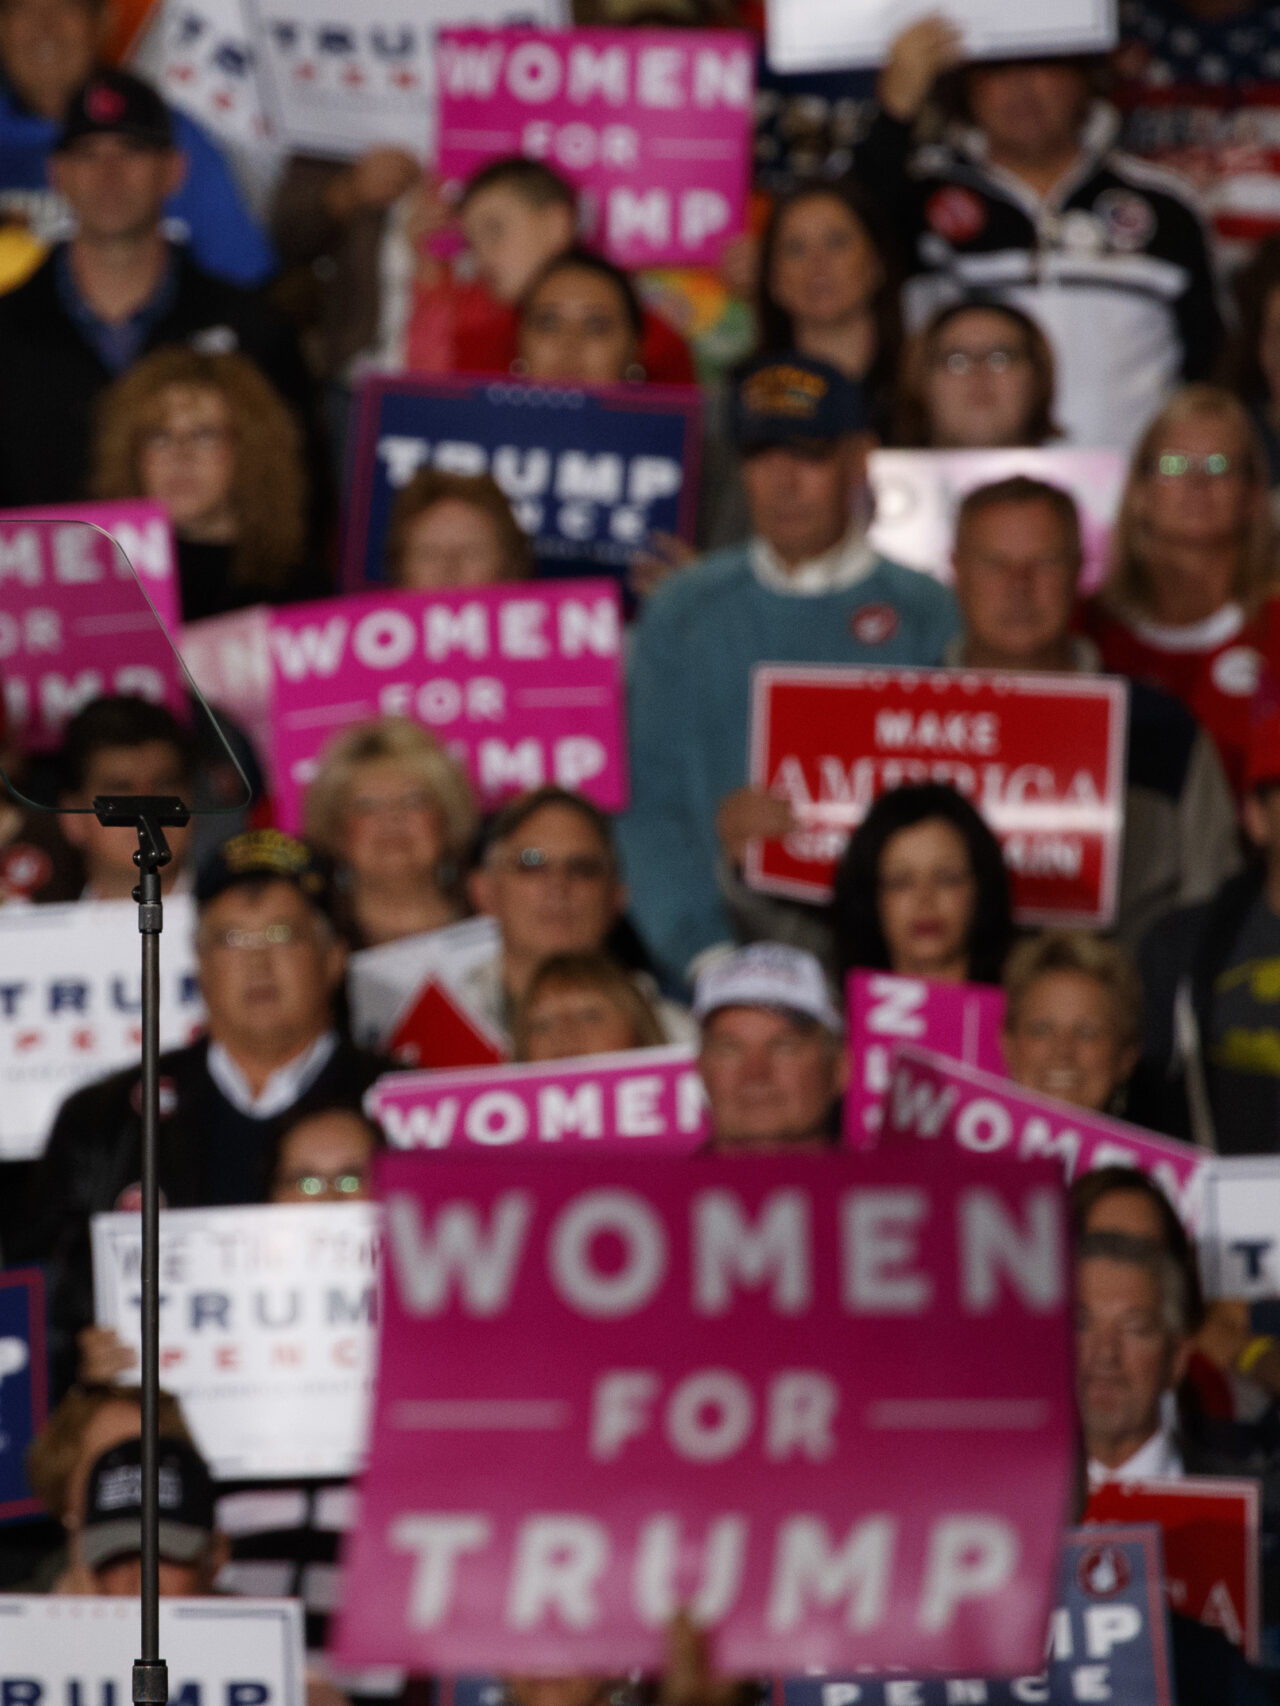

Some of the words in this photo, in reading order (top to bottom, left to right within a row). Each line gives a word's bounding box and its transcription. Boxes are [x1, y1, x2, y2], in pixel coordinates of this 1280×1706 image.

[440, 40, 754, 110] WOMEN
[523, 120, 640, 172] FOR
[272, 597, 619, 682] WOMEN
[379, 676, 506, 725] FOR
[874, 708, 1001, 756] MAKE
[386, 1186, 1067, 1319] WOMEN
[131, 1284, 378, 1334] RUM
[159, 1337, 357, 1374] PENC
[589, 1367, 839, 1464] FOR
[386, 1512, 1017, 1636] TRUMP
